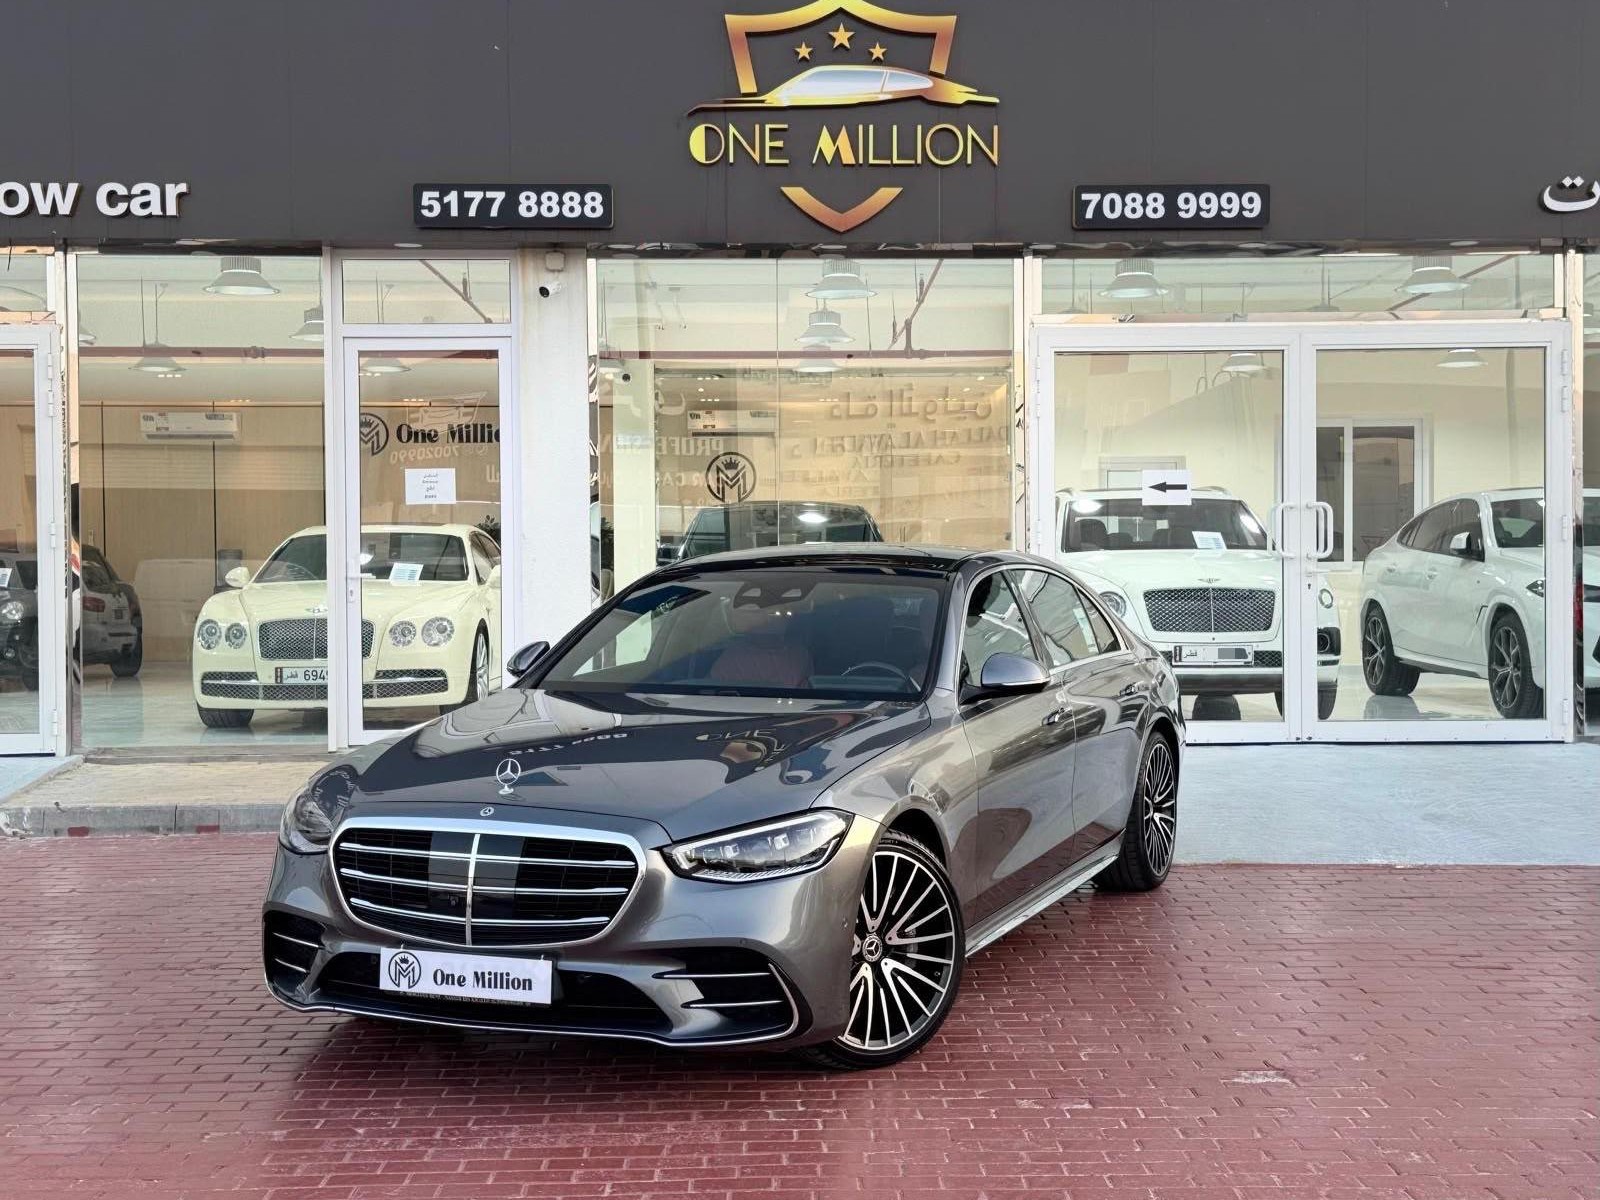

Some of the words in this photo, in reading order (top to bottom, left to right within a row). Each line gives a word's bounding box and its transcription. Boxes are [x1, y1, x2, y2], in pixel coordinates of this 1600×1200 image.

[689, 122, 789, 165] ONE
[812, 122, 999, 165] MILLION
[96, 181, 188, 217] car
[420, 190, 505, 219] 5177
[518, 190, 604, 220] 8888
[1081, 191, 1166, 221] 7088
[1177, 191, 1263, 219] 9999
[396, 422, 440, 444] One
[433, 968, 466, 987] One
[473, 970, 533, 991] Million
